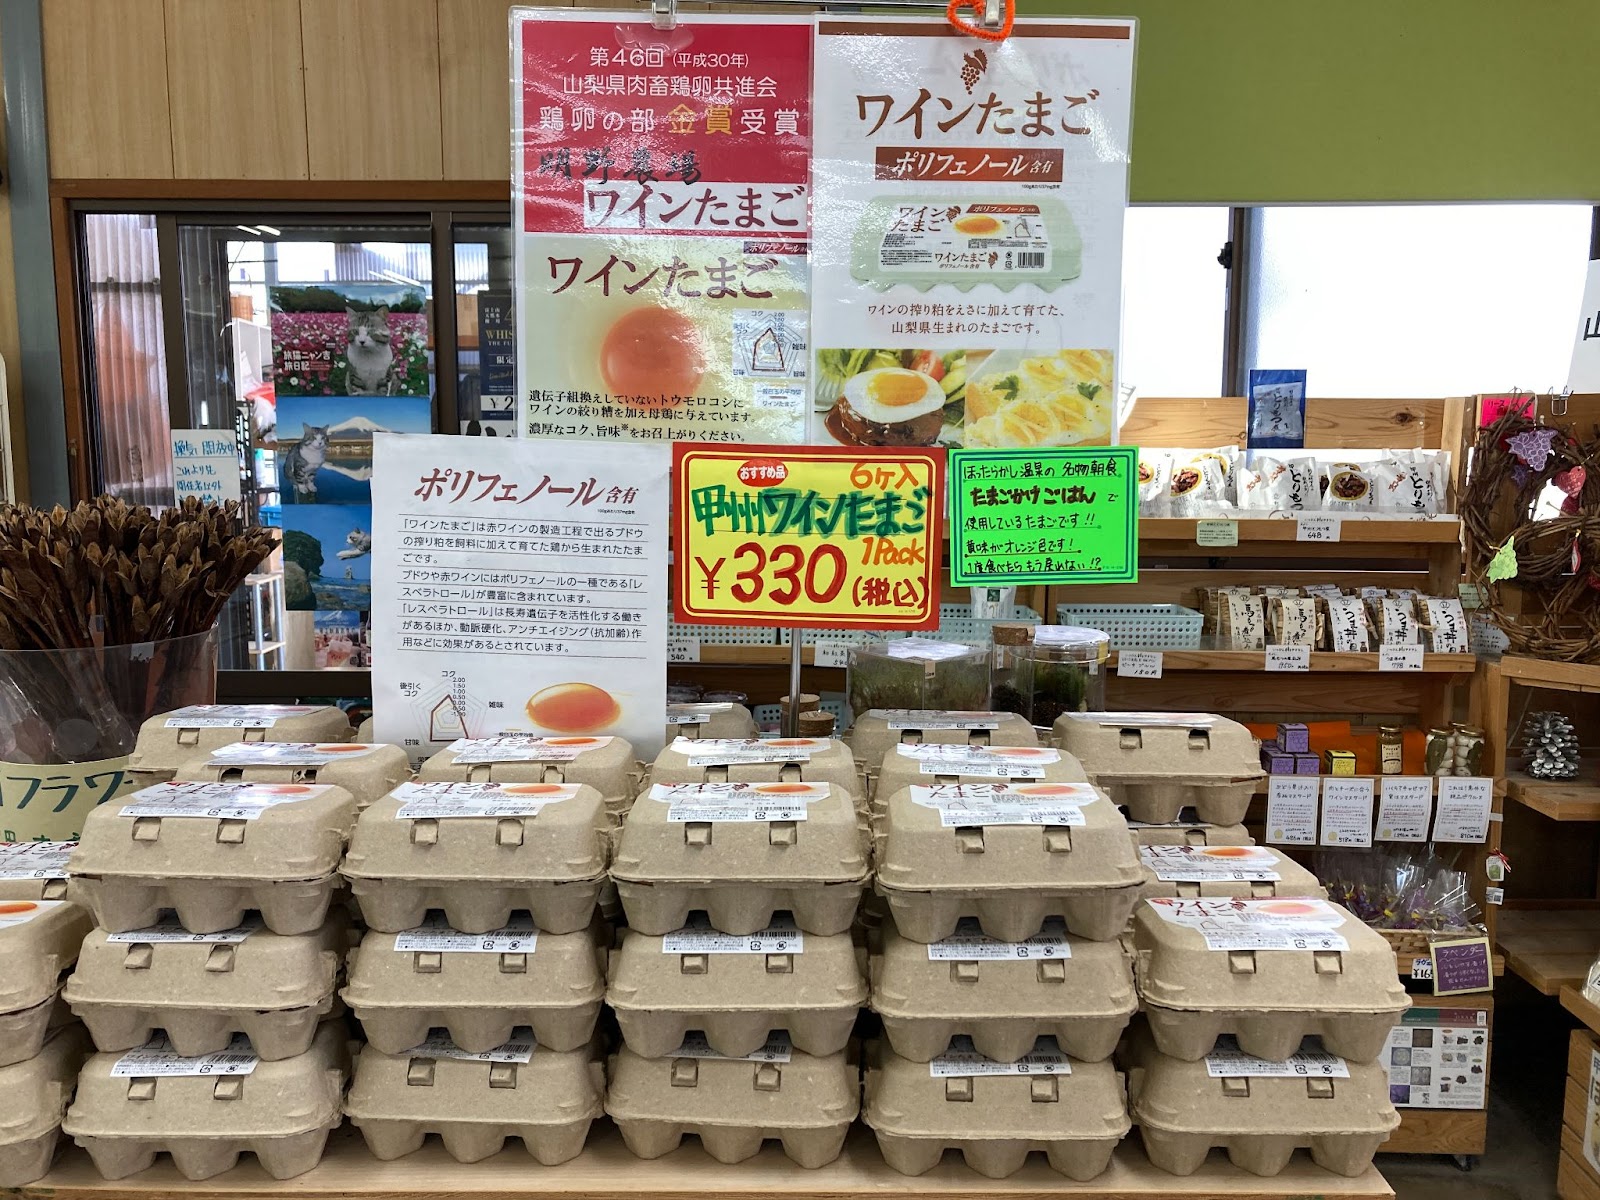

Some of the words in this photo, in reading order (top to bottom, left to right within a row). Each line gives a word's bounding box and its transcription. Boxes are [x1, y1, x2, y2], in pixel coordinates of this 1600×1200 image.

[589, 46, 665, 69] 第46回
[672, 52, 750, 69] (平成30年)
[562, 74, 778, 98] 山梨県肉畜鶏卵共進会
[856, 87, 1100, 140] ワインたまご
[586, 184, 808, 229] ワインたまご
[899, 205, 947, 219] ワイン
[890, 219, 946, 233] たまご
[934, 250, 988, 264] ワインたまご
[547, 254, 780, 299] ワインたまご
[867, 303, 1066, 318] ワインの搾り粕をえさに加えて育てた、
[891, 320, 1042, 335] 山梨県生まれのたまごです。
[528, 389, 744, 408] 遺伝子組換えしていないトウモロコシに
[739, 465, 787, 480] おすすめ品
[1061, 456, 1118, 478] 名物朝食
[969, 484, 1097, 508] たまごかけごはん
[691, 485, 932, 540] 甲州ワインたまご
[403, 519, 645, 539] 「ワインたまご」は赤ワインの製造工程で出るブドウ
[402, 535, 644, 556] の搾り粕を飼料に加えて育てた鶏から生まれたたま
[402, 553, 439, 565] ごです。
[402, 570, 643, 590] ブドウや赤ワインにはポリフェノールの一種である「レ
[402, 586, 592, 604] スベラトロール」が豊富に含まれています。
[851, 575, 929, 610] (税込)
[402, 603, 642, 623] 「レスベラトロール」は長寿遺伝子を活性化する働き
[402, 637, 569, 654] 用などに効果があるとされています。
[441, 670, 456, 678] コク
[399, 682, 422, 690] 後引く
[488, 701, 504, 709] 雑味
[404, 738, 420, 746] 甘味
